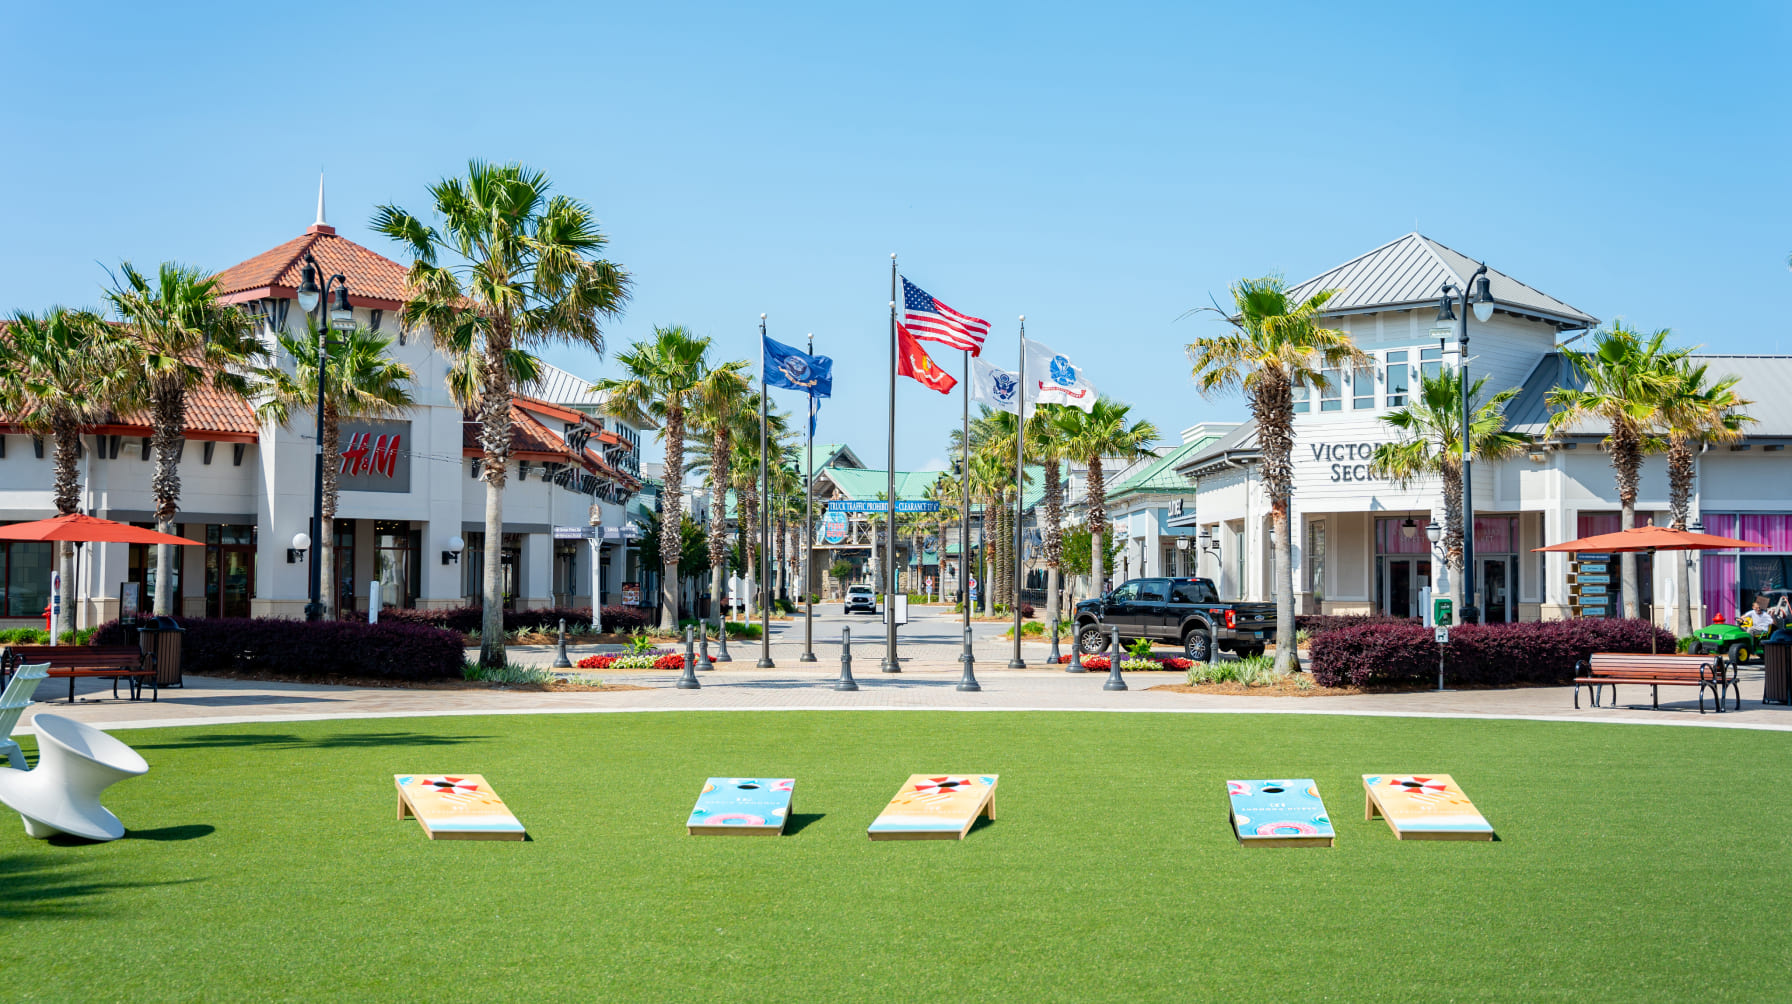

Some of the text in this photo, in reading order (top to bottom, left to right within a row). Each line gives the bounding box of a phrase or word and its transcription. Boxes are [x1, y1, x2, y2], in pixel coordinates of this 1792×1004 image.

[339, 432, 401, 478] H&M
[829, 502, 846, 511] TRUCK
[847, 502, 866, 511] TRAFFIC
[899, 502, 927, 511] CLEARANCE
[827, 522, 845, 530] FISH
